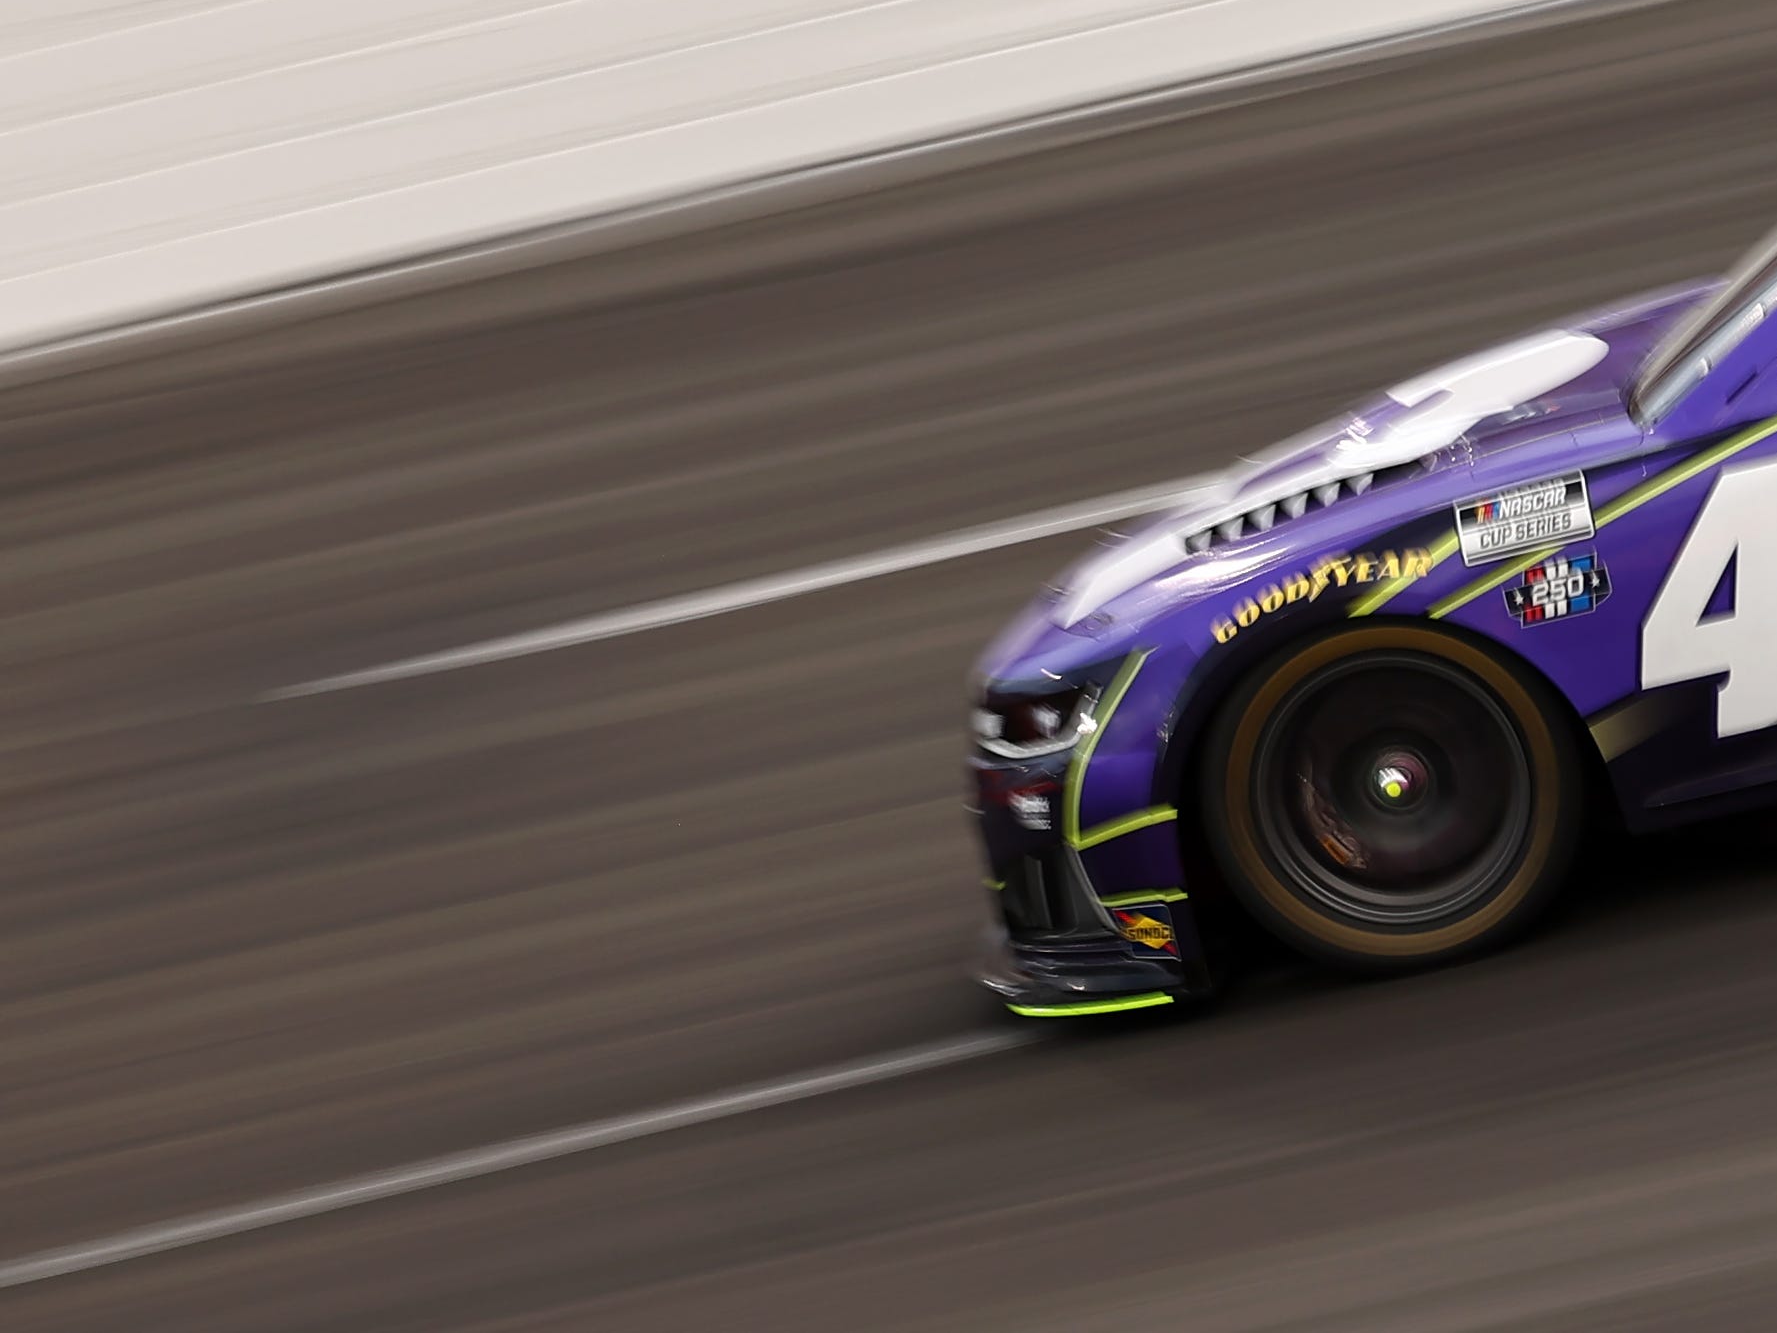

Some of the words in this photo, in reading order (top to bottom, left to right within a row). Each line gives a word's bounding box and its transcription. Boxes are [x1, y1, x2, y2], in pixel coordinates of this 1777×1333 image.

[1498, 482, 1567, 518] NASCAR
[1479, 522, 1514, 549] CUP
[1514, 511, 1573, 543] SERIES
[1209, 545, 1434, 645] GOODYEAR
[1530, 574, 1586, 608] 250
